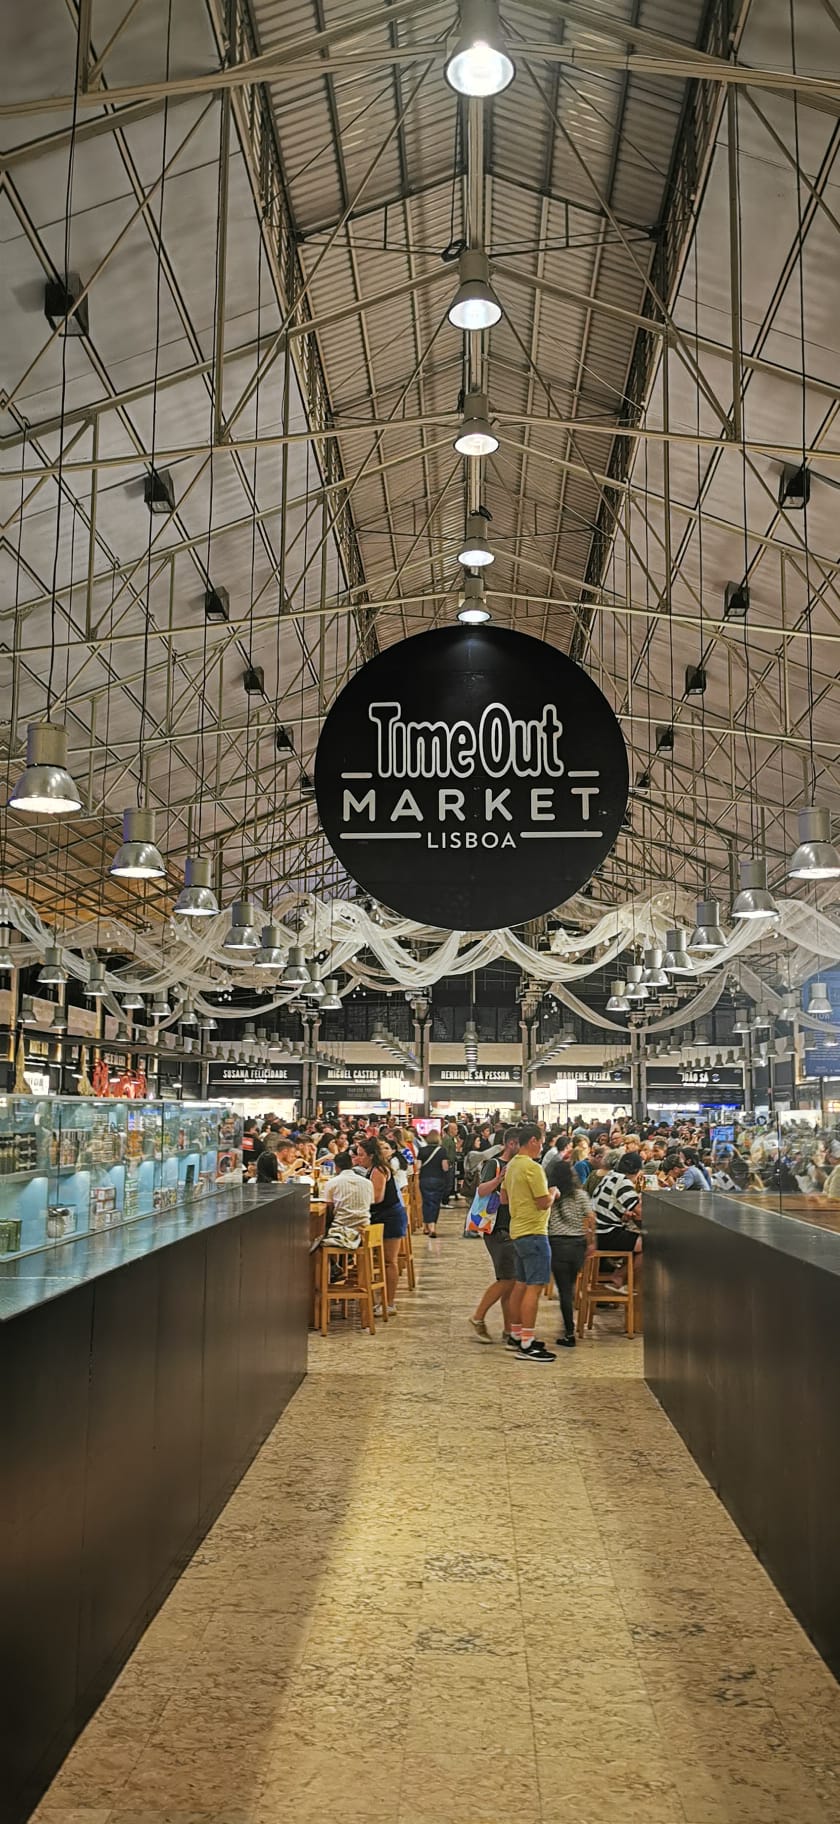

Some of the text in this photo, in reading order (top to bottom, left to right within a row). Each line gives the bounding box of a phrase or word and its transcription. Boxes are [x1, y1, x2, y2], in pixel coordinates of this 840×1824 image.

[368, 702, 564, 778] Time Out
[342, 788, 600, 822] MARKET
[427, 831, 517, 849] LISBOA
[222, 1069, 288, 1079] SUSANA FELICIDADE
[327, 1069, 352, 1079] MIGUEL
[353, 1069, 378, 1079] CASTRO
[440, 1070, 473, 1080] HENRIQUE
[485, 1071, 510, 1080] PESSOA
[588, 1071, 611, 1081] VIEIRA
